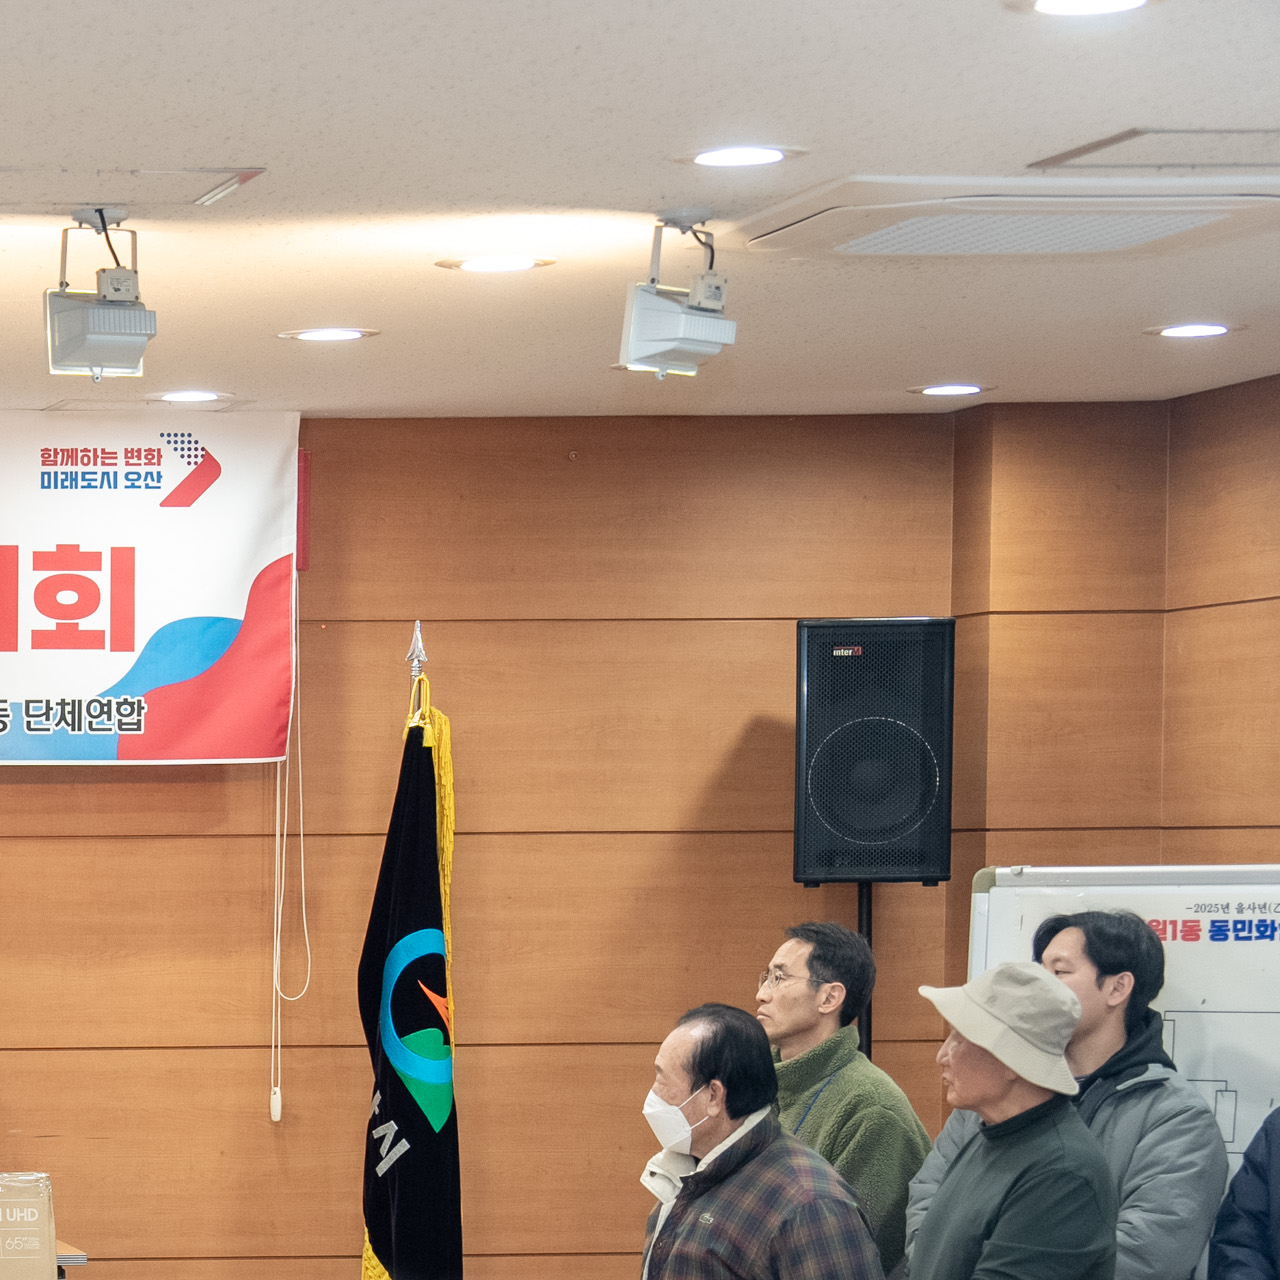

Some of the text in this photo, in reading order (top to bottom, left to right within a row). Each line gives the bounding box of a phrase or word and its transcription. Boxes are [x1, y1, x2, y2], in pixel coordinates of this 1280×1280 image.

[40, 446, 163, 468] 함께하는 변화
[40, 470, 163, 491] 미래도시 오산
[23, 697, 145, 734] 단체연합
[1186, 903, 1230, 914] -2025년
[1208, 919, 1280, 942] 동민화
[6, 1208, 39, 1222] UHD
